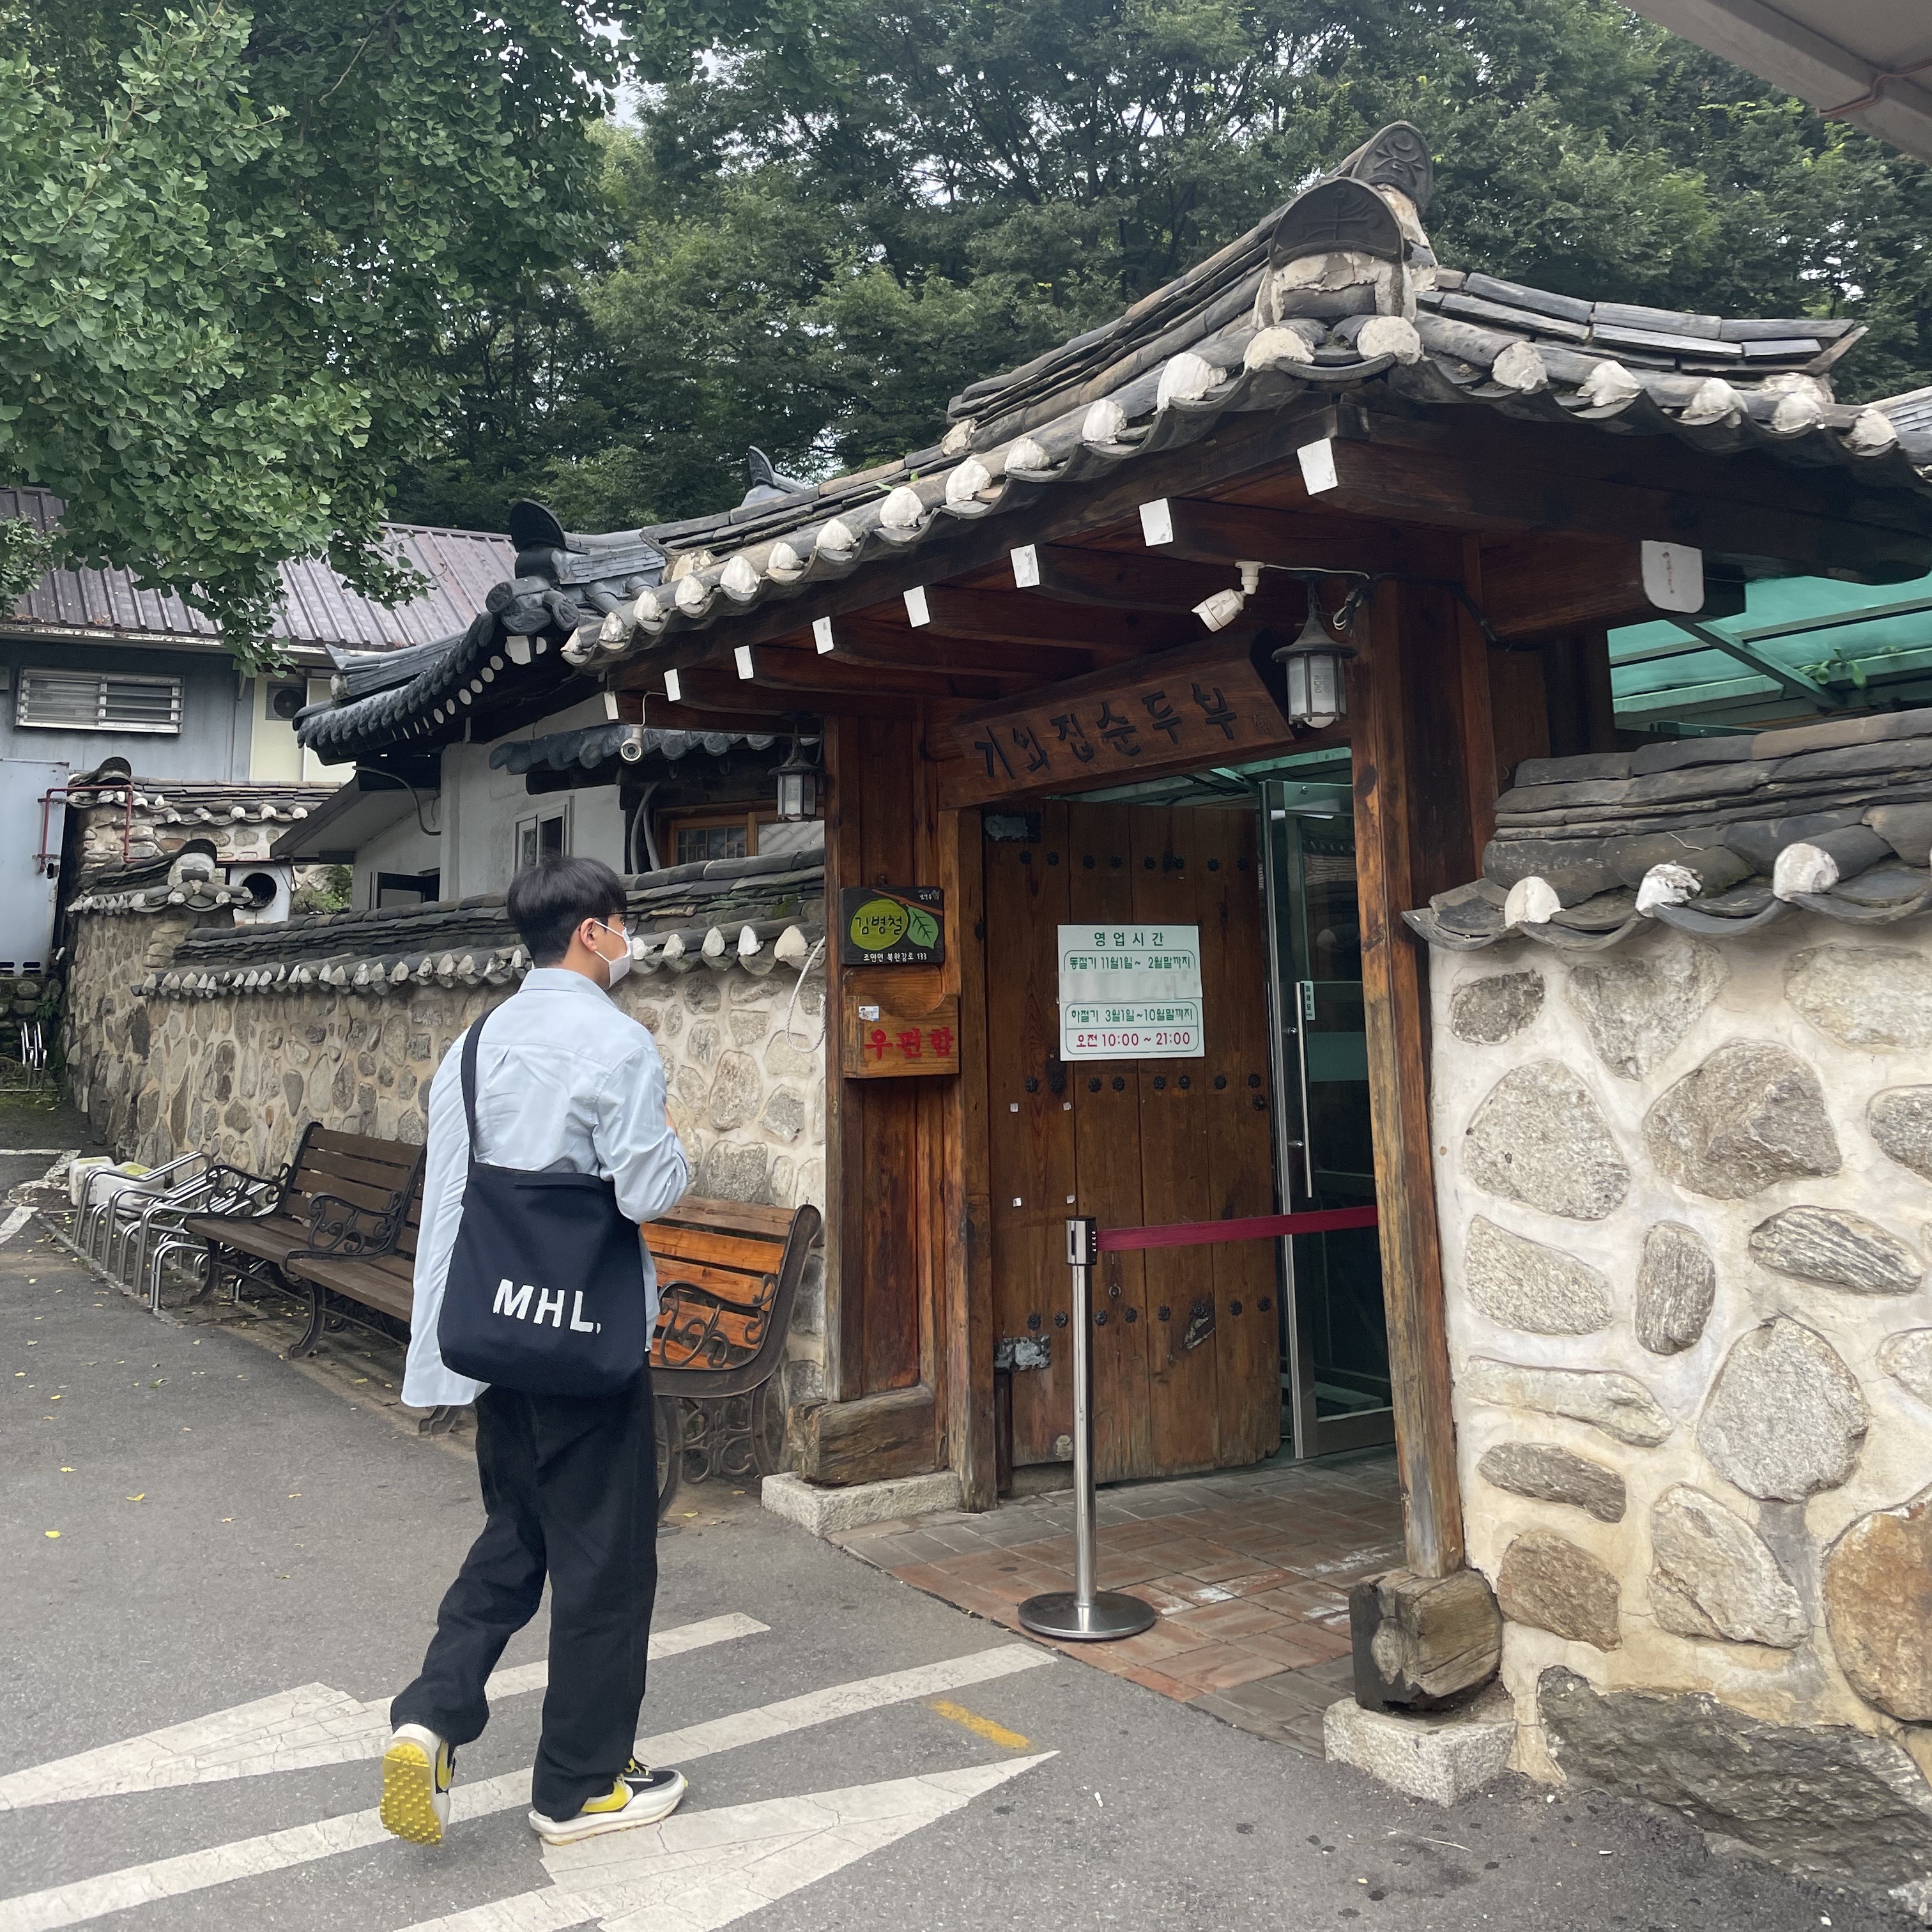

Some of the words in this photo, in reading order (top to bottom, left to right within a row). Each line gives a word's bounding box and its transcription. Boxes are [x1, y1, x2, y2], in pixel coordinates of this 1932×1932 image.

[854, 914, 902, 935] 김병철
[863, 953, 884, 962] 조안면
[887, 952, 914, 962] 북한강로
[1070, 956, 1096, 970] 동절기
[1071, 1009, 1099, 1023] 하절기
[1076, 1034, 1098, 1048] 오전
[1102, 1033, 1139, 1046] 10:00
[1156, 1032, 1190, 1045] 21:00
